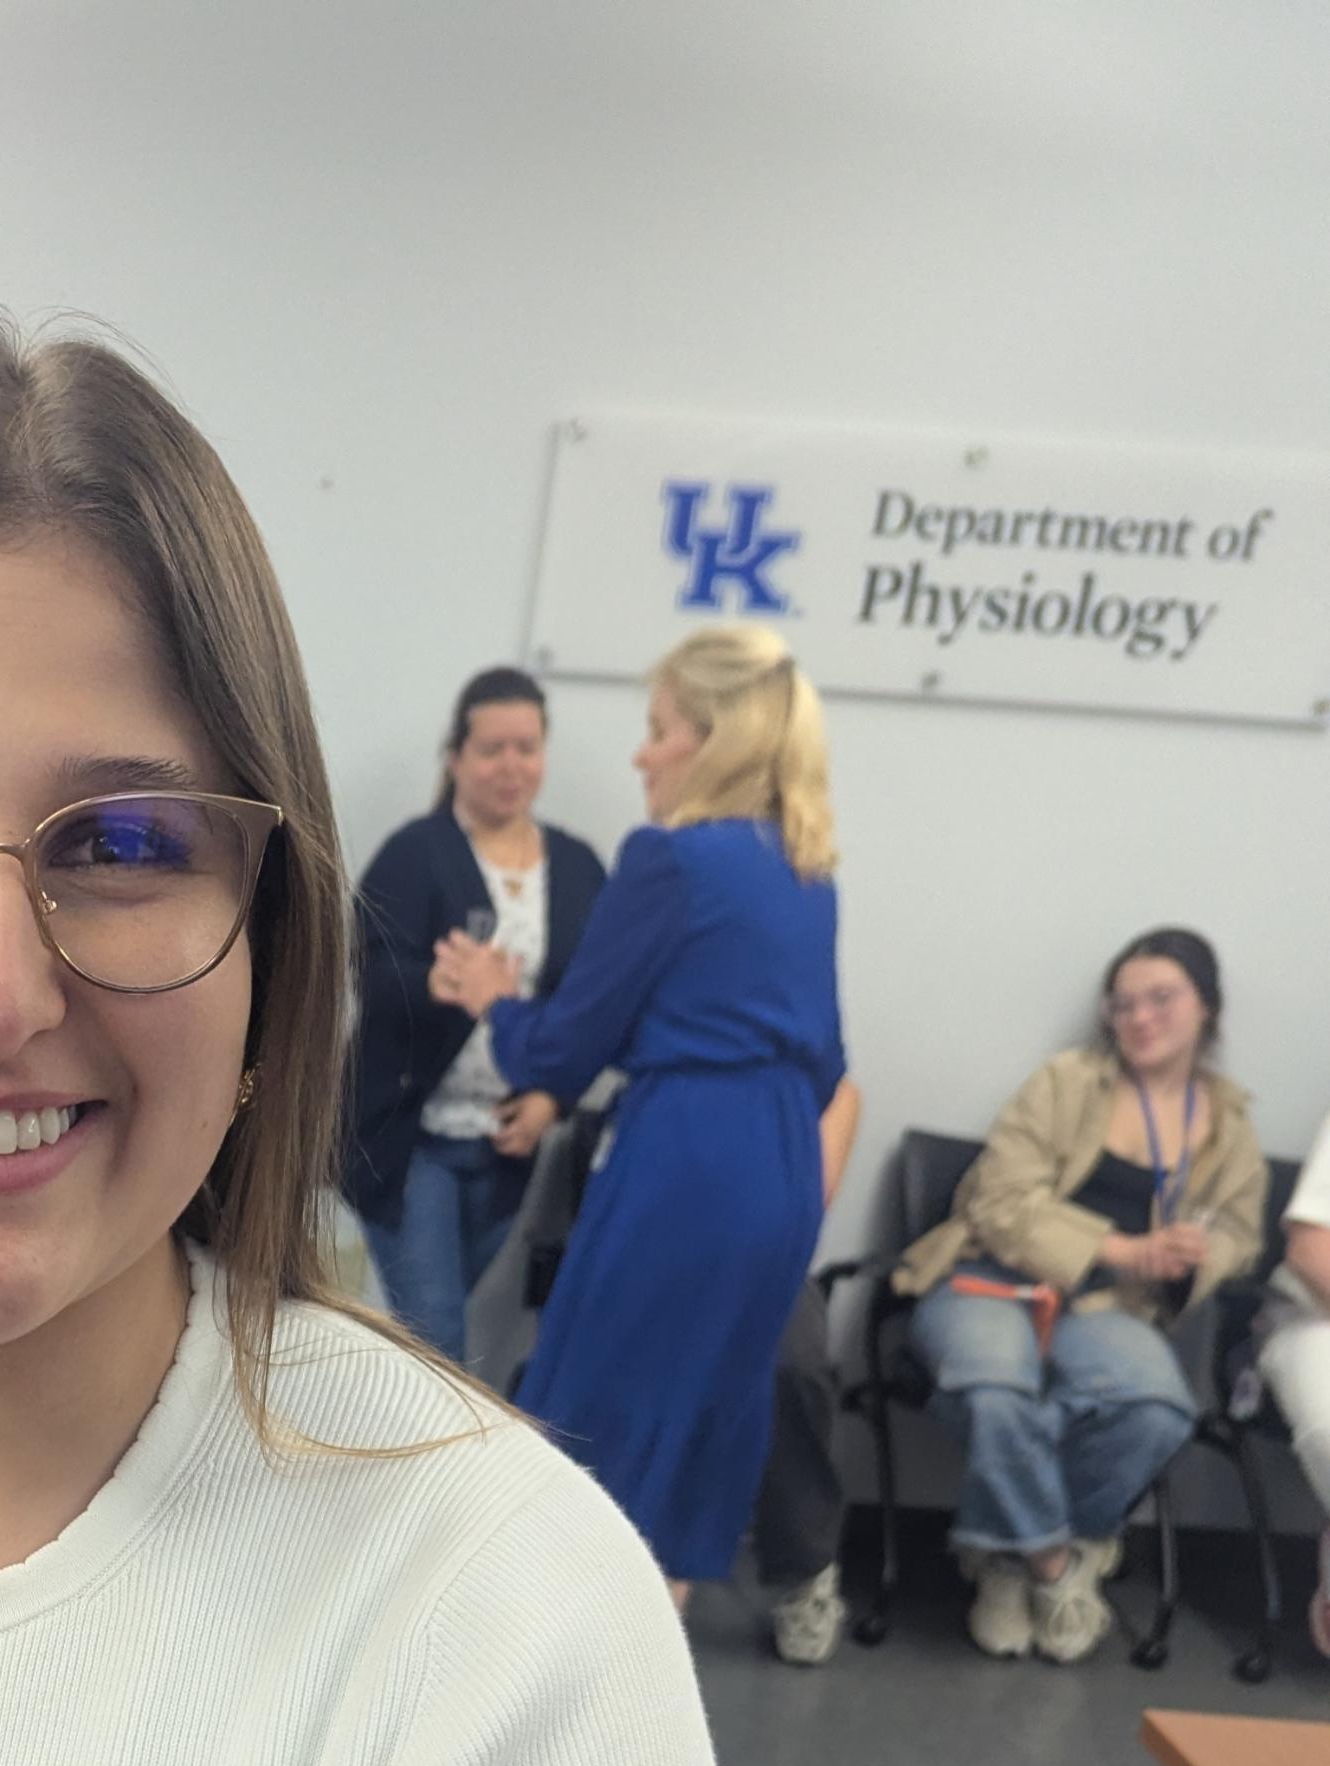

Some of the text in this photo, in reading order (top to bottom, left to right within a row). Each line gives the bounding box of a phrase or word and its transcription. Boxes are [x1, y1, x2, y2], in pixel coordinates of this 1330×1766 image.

[662, 480, 802, 616] UK
[872, 489, 1274, 562] Department of
[856, 564, 1219, 663] Physiology
